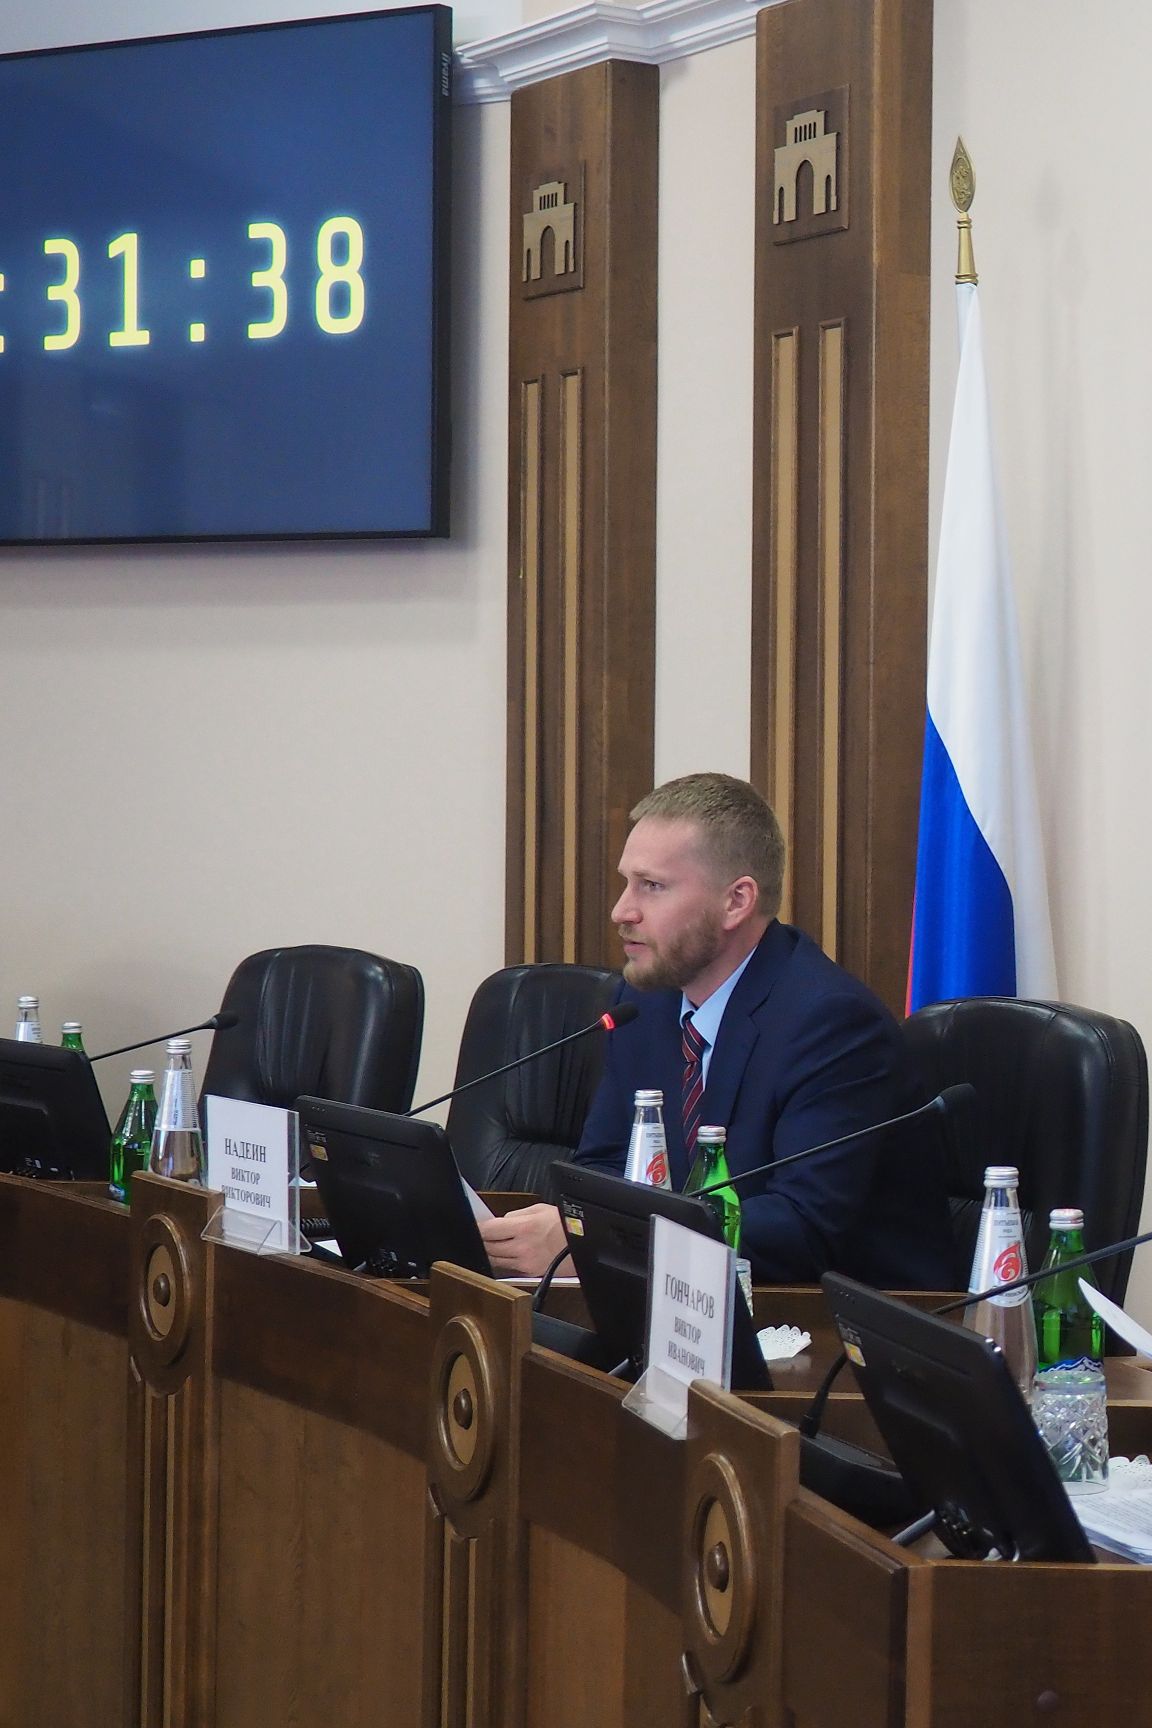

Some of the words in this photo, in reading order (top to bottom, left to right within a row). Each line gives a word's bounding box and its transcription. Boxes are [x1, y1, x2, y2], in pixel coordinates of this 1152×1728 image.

[224, 1138, 267, 1163] НАДЕИН
[231, 1167, 261, 1185] ВИКТОР
[664, 1273, 715, 1319] ГОНЧАРОВ
[674, 1316, 702, 1345] ВИКТОР
[667, 1340, 706, 1376] ИВАНОВИЧ
